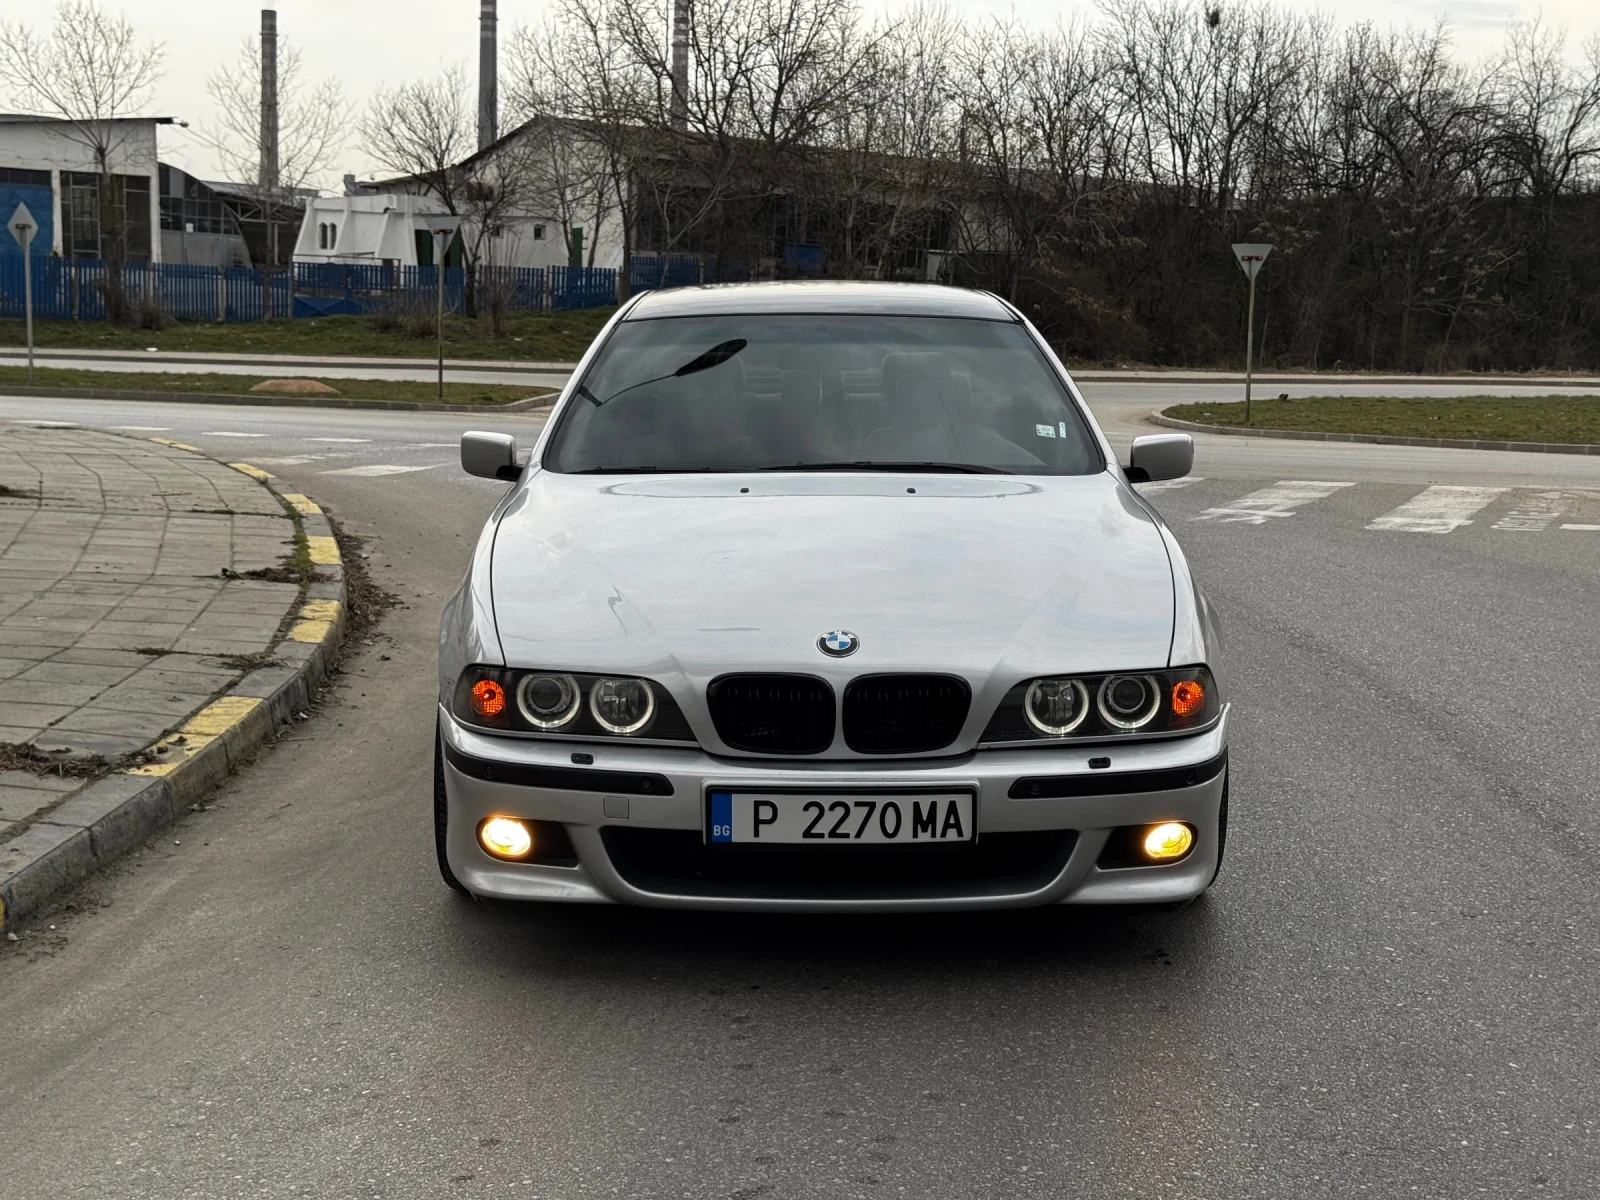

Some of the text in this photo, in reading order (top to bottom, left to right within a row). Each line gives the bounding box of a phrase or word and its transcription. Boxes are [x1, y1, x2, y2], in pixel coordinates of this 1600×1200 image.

[713, 825, 730, 836] BG
[753, 800, 964, 839] P 2270 MA
